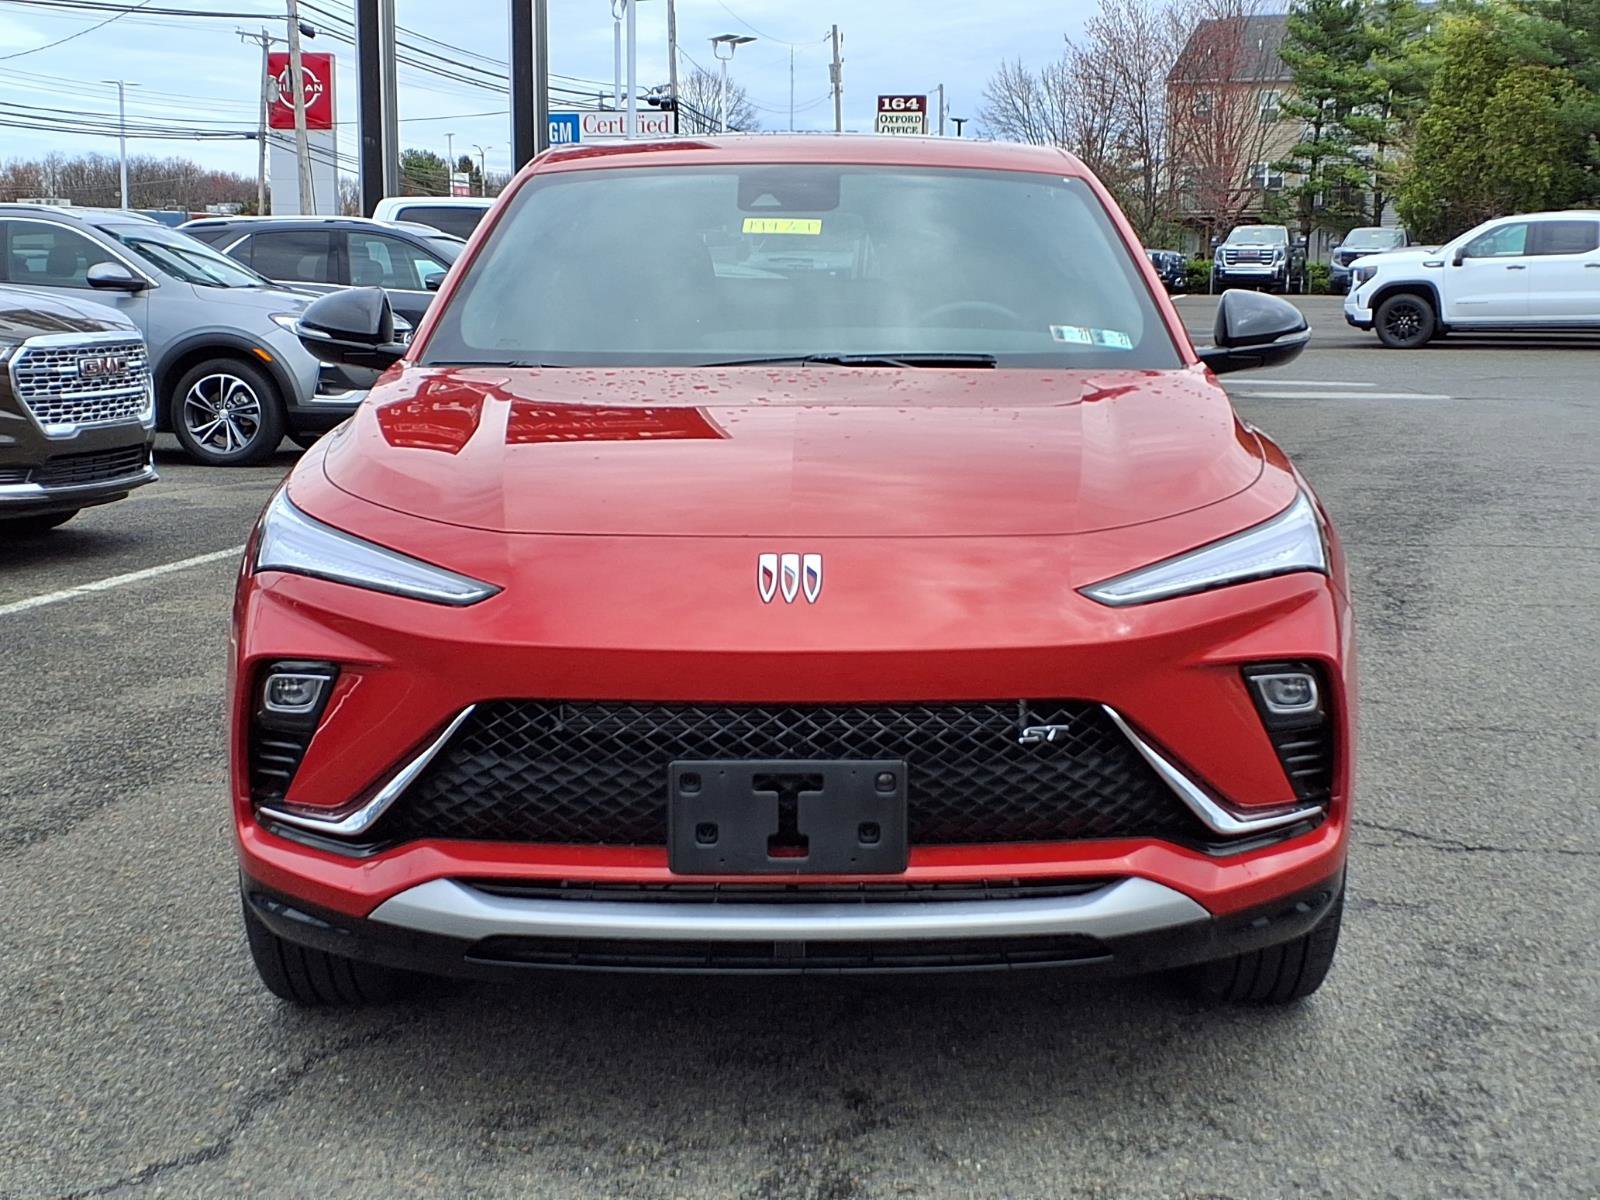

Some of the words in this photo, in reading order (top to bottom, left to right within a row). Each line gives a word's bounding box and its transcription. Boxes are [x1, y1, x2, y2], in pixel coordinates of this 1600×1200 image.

[881, 97, 920, 110] 164
[880, 114, 921, 124] OXFORD
[549, 122, 572, 143] GM
[582, 114, 669, 134] Certied
[881, 125, 919, 134] OFFICE
[80, 357, 129, 377] GMC
[1019, 725, 1069, 744] ST
